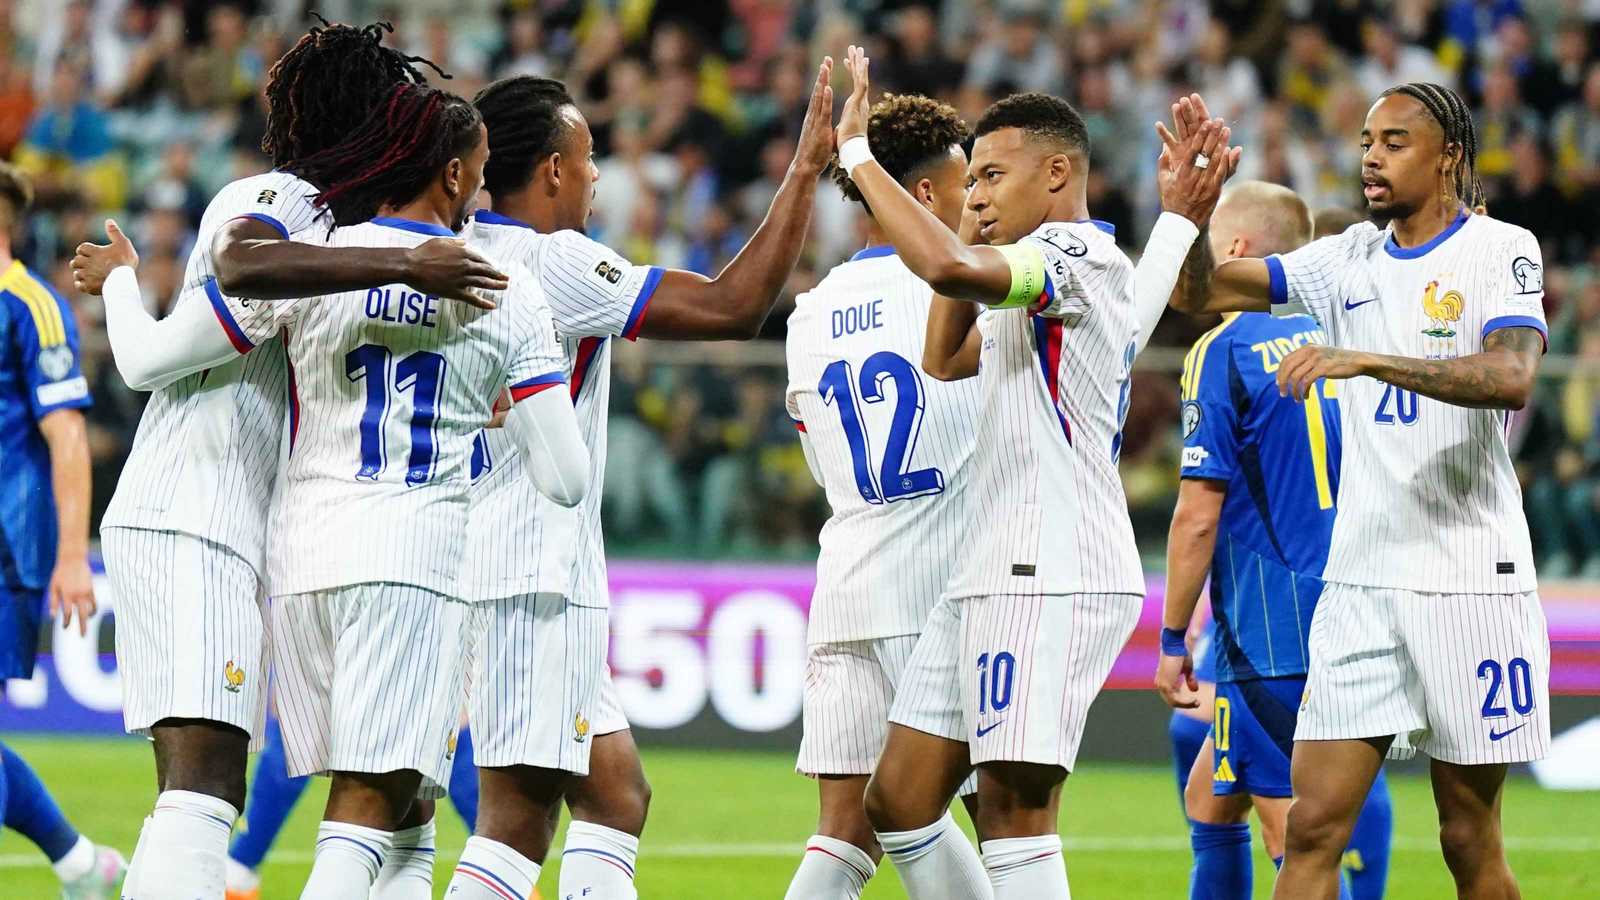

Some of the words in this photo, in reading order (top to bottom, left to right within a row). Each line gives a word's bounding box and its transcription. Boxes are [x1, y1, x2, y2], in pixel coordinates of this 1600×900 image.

[364, 287, 440, 328] OLISE
[832, 300, 883, 339] DOUE
[345, 343, 448, 487] 11
[818, 351, 945, 504] 12
[1374, 378, 1420, 427] 20
[1304, 379, 1344, 510] 1
[977, 651, 1017, 716] 10
[1477, 657, 1536, 720] 20
